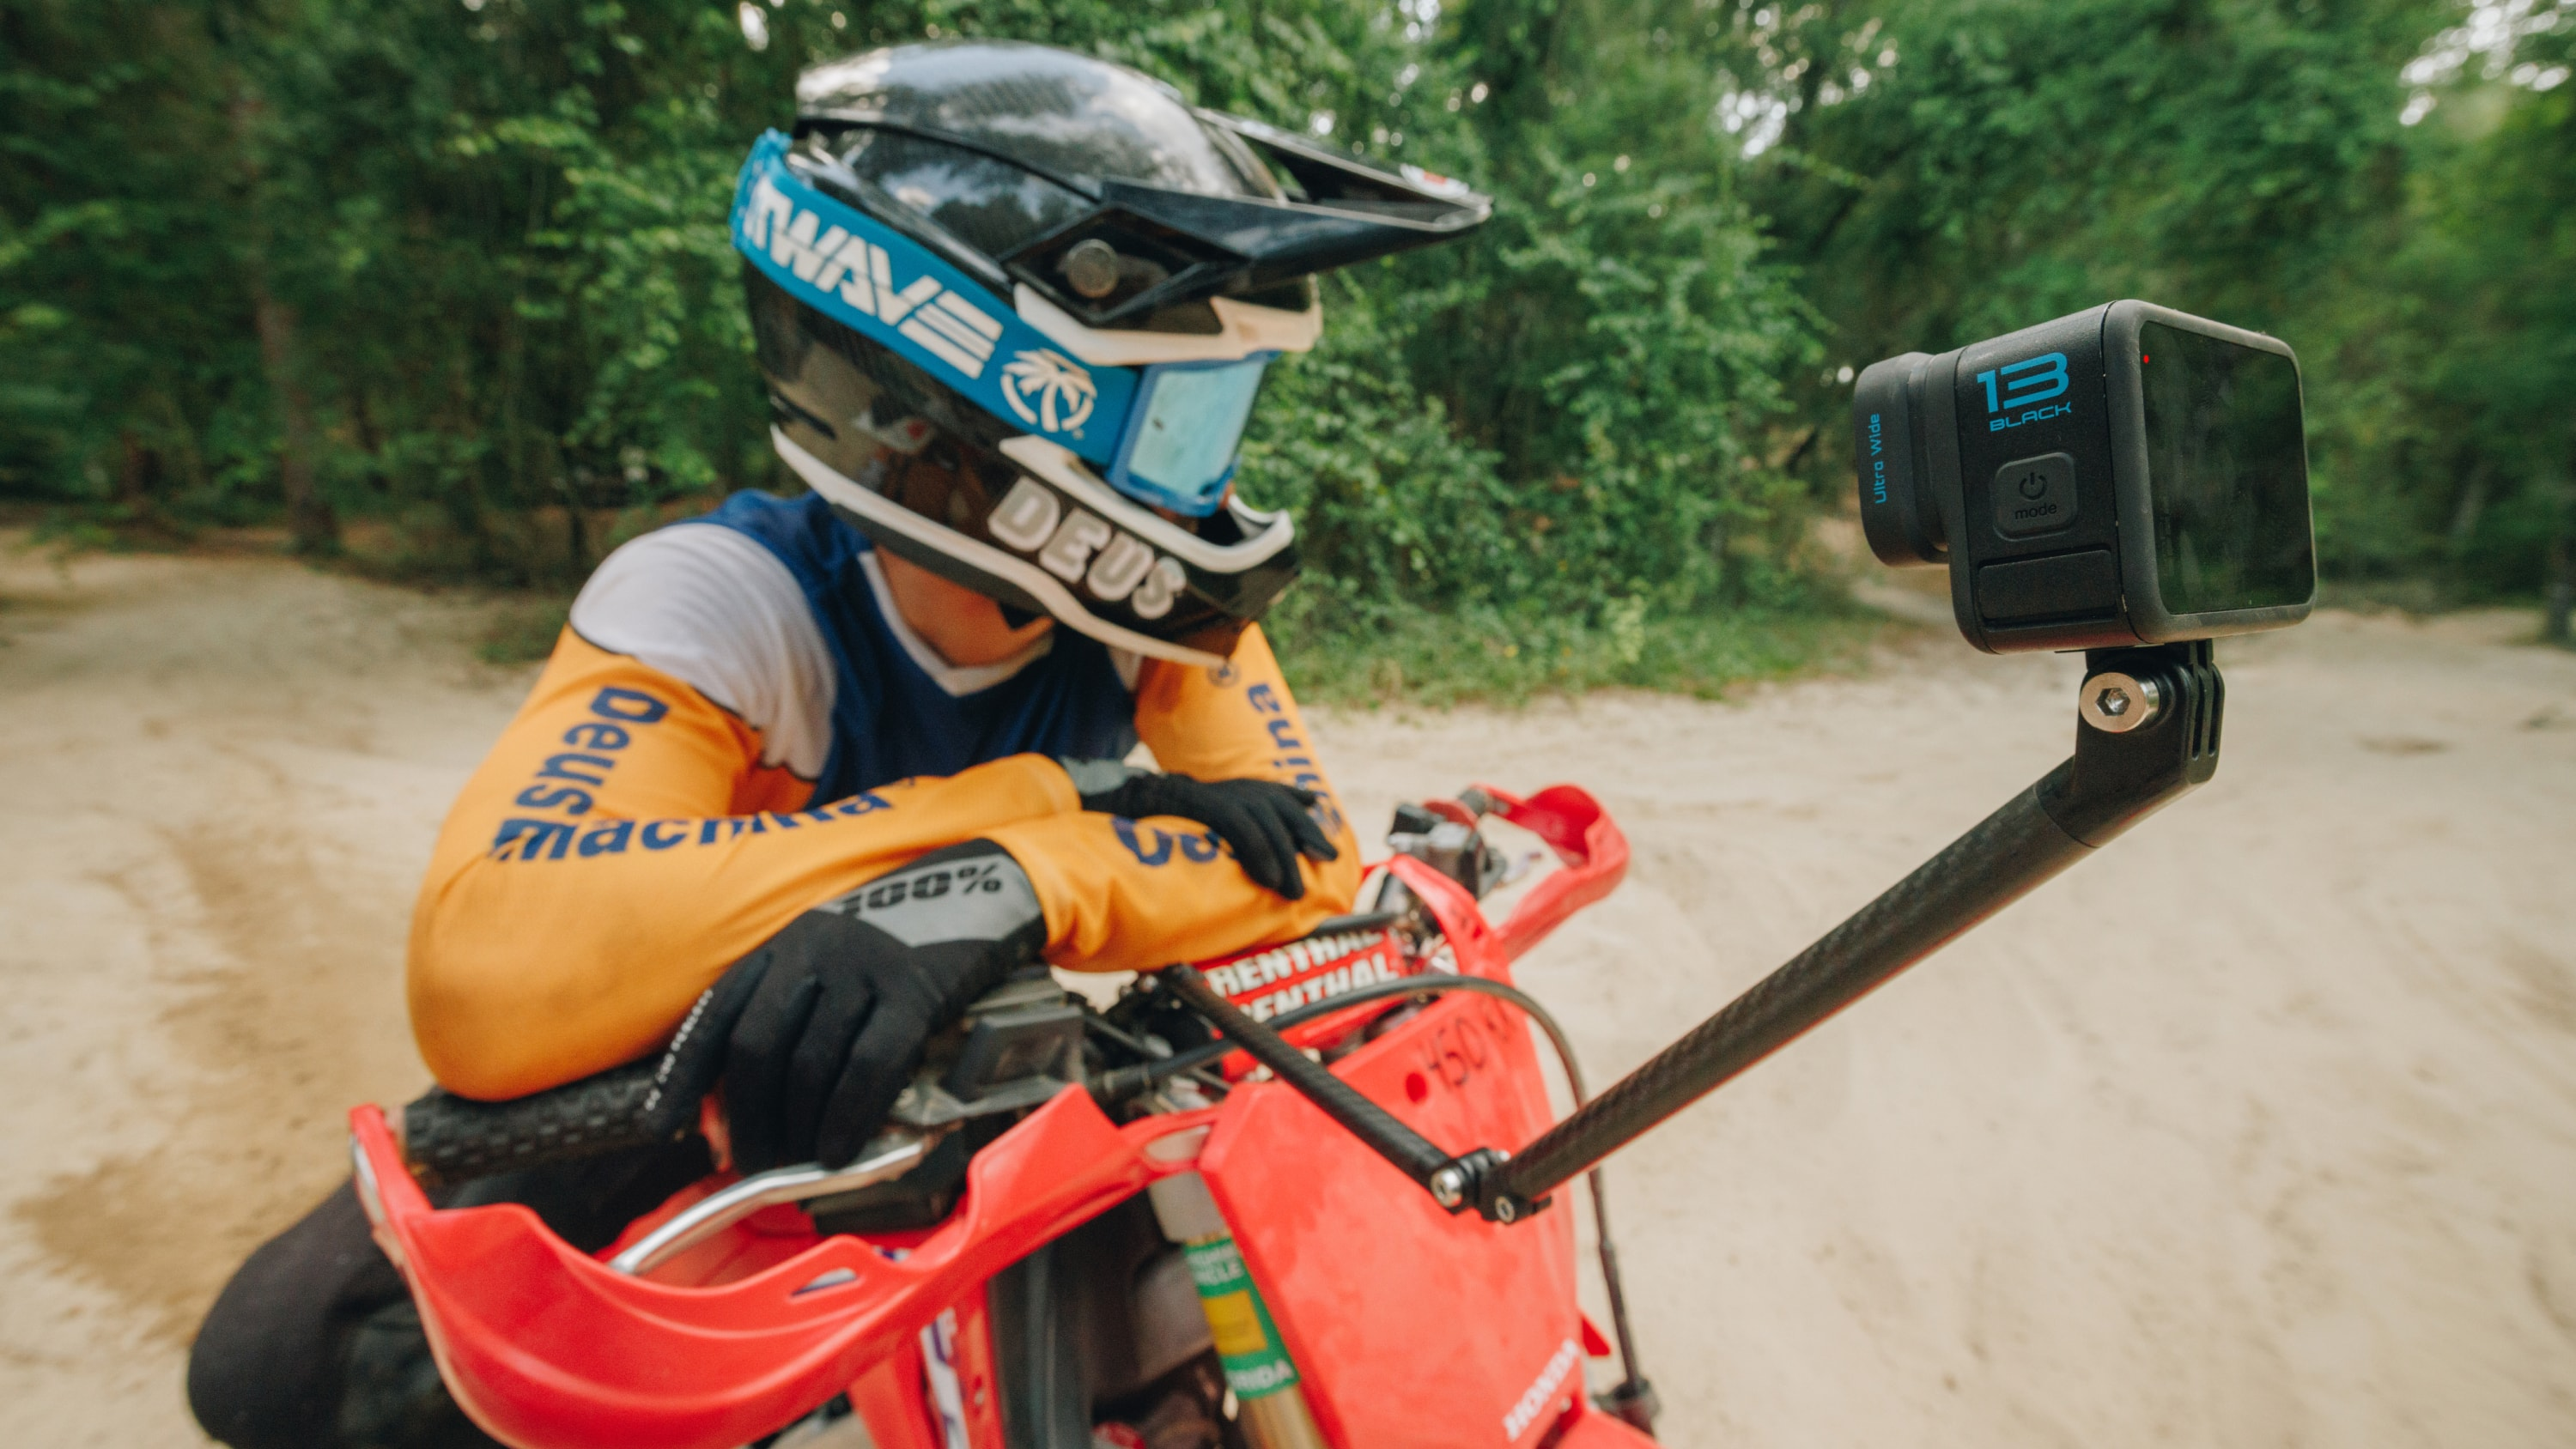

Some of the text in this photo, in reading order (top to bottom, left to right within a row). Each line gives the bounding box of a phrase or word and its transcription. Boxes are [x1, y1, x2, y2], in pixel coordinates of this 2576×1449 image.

[1977, 352, 2069, 413] 13
[1989, 401, 2072, 432] BLACK
[1868, 413, 1887, 504] Ultra Wide
[2014, 502, 2057, 520] mode
[988, 475, 1187, 620] DEUS
[514, 686, 670, 815] Deus
[1237, 951, 1400, 1023] ENTHAL
